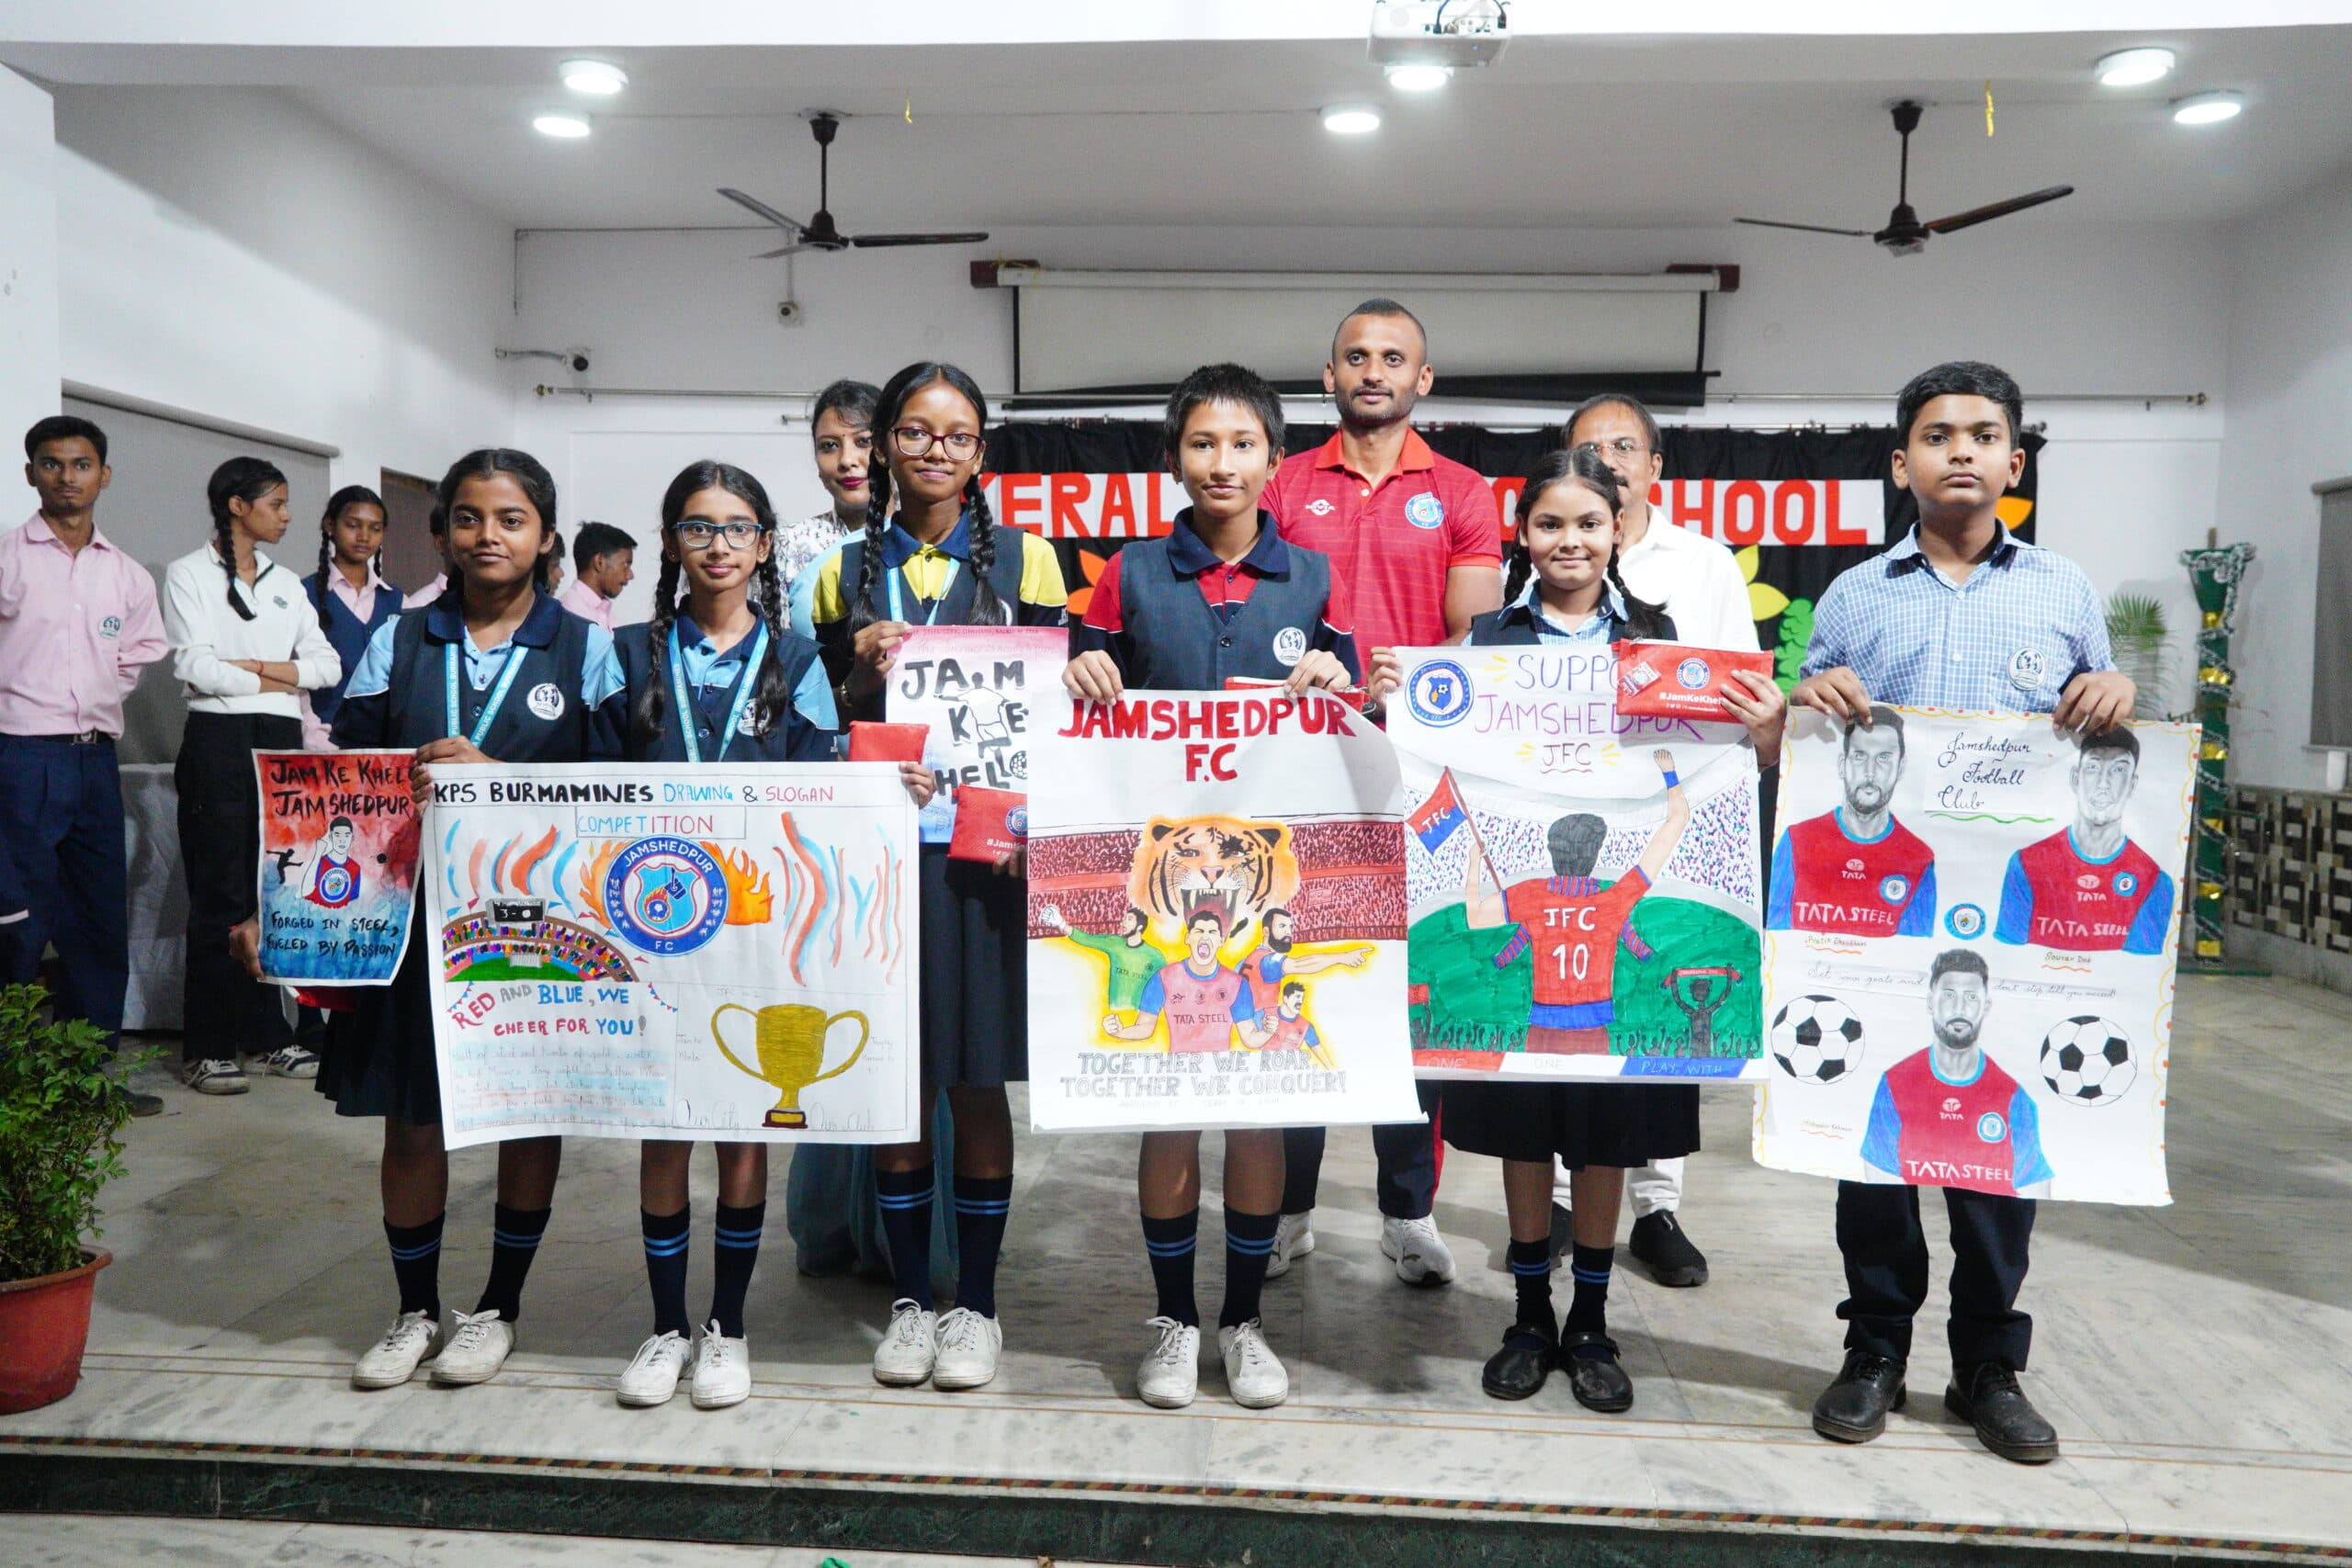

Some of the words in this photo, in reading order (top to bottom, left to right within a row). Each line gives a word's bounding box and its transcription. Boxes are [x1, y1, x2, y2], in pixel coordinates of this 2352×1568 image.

[978, 472, 1175, 538] ERAL
[1647, 479, 1867, 546] HOOL
[1659, 692, 1723, 705] #JamKeKhel
[475, 716, 491, 740] PUBLIC
[488, 691, 503, 715] SCHOOL
[1057, 696, 1357, 740] JAMSHEDPUR
[1542, 742, 1591, 767] JFC
[1939, 732, 2031, 768] Jamshedpur
[268, 760, 318, 784] JAM
[322, 759, 349, 789] KE
[1185, 743, 1238, 783] F.C
[1962, 761, 2024, 785] Football
[434, 784, 477, 804] KPS
[490, 782, 654, 804] BURMAMINES
[663, 783, 733, 803] DRAWING
[742, 785, 759, 802] &
[765, 784, 833, 803] SLOGAN
[1938, 785, 1984, 809] Club
[576, 815, 714, 835] COMPETITION
[1421, 806, 1452, 832] JFC
[625, 840, 714, 873] JAMSHEDPUR
[1841, 871, 1866, 880] TATA
[2076, 892, 2107, 901] TATA
[271, 911, 314, 929] FORGED
[322, 919, 340, 929] IN
[1543, 906, 1597, 931] JFC
[1794, 902, 1846, 924] TATA
[1850, 907, 1894, 925] STEEL
[2037, 917, 2088, 937] TATA
[318, 940, 339, 957] BY
[344, 940, 395, 958] PASSION
[1552, 943, 1589, 980] 10
[451, 991, 496, 1031] RED
[499, 984, 534, 1005] AND
[597, 987, 629, 1005] WE
[1173, 1015, 1194, 1024] TATA
[1198, 1014, 1227, 1023] STEEL
[493, 1020, 548, 1038] CHEER
[556, 1018, 588, 1035] FOR
[1078, 1052, 1204, 1075] TOGETHER
[1212, 1051, 1250, 1073] WE
[1641, 1061, 1676, 1074] PLAY
[1687, 1065, 1723, 1074] WITH
[1060, 1075, 1182, 1099] TOGETHER
[1193, 1076, 1229, 1097] WE
[1238, 1071, 1347, 1098] CONQUER!
[1905, 1159, 1960, 1179] TATA
[1962, 1164, 2012, 1181] STEEL
